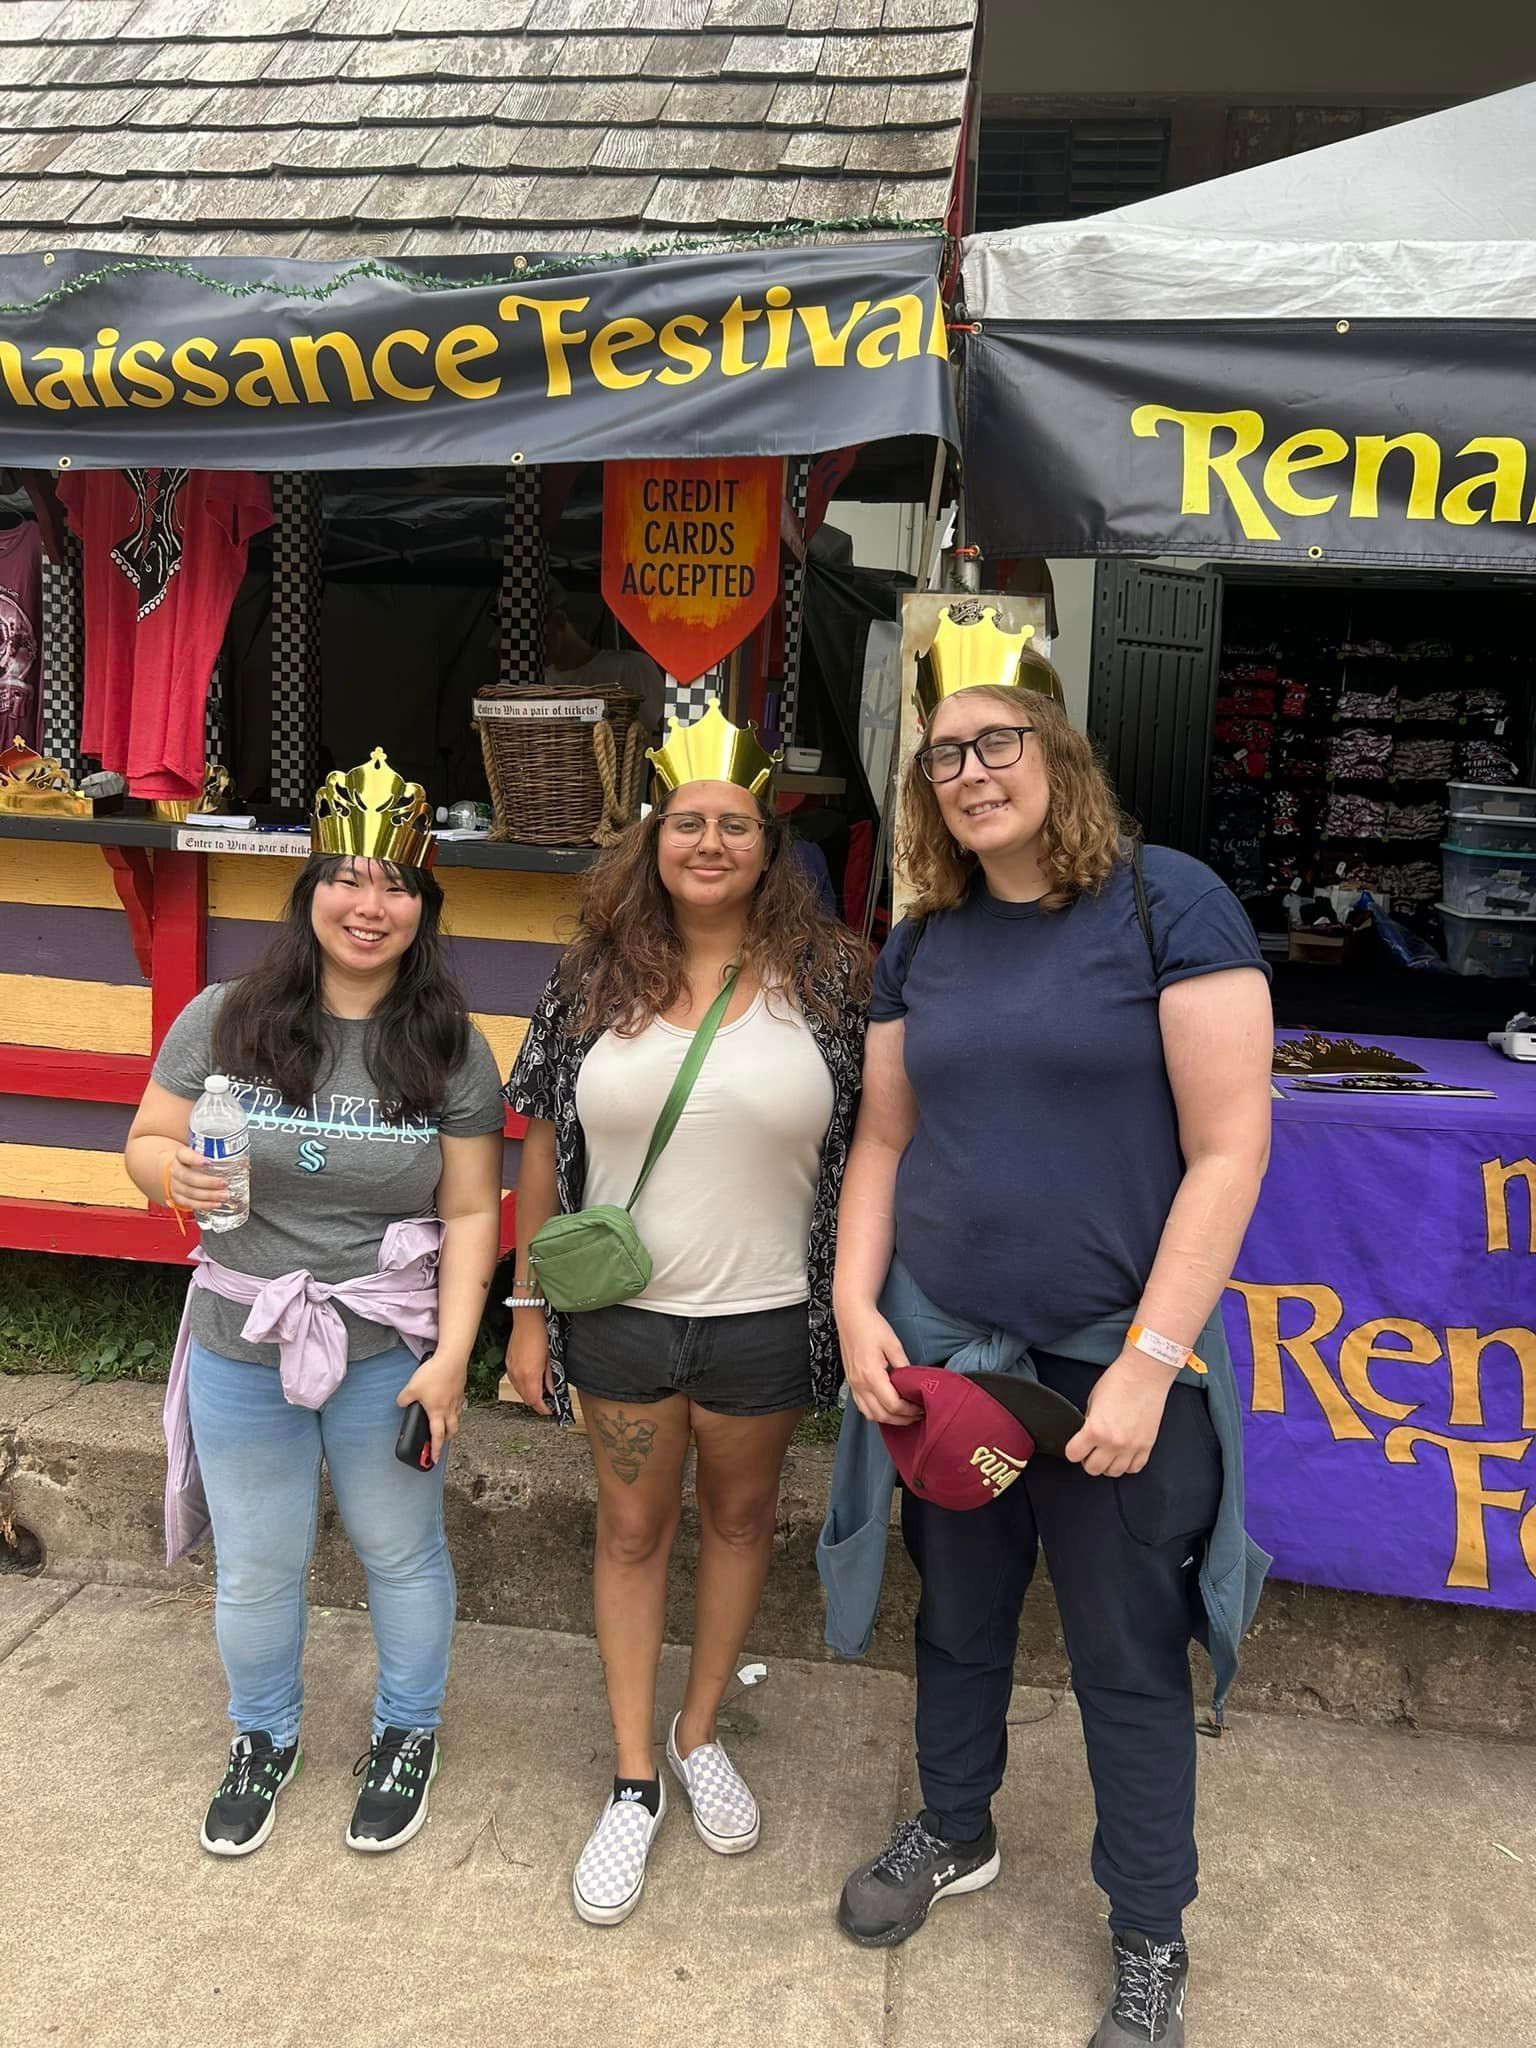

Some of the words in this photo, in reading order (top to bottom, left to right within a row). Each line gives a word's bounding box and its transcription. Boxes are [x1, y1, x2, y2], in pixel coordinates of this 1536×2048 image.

[1130, 404, 1536, 541] Rena
[643, 478, 739, 513] CREDIT
[644, 520, 735, 555] CARDS
[621, 562, 756, 597] ACCEPTED
[477, 704, 493, 715] Enter
[494, 705, 501, 714] to
[503, 704, 520, 715] Win
[522, 706, 528, 715] a
[530, 706, 549, 716] pair
[552, 705, 561, 715] of
[564, 705, 598, 716] tickets!
[185, 837, 213, 848] Enter
[215, 839, 224, 849] to
[226, 839, 247, 850] Win
[249, 842, 256, 850] a
[258, 843, 277, 853] pair
[279, 843, 289, 853] of
